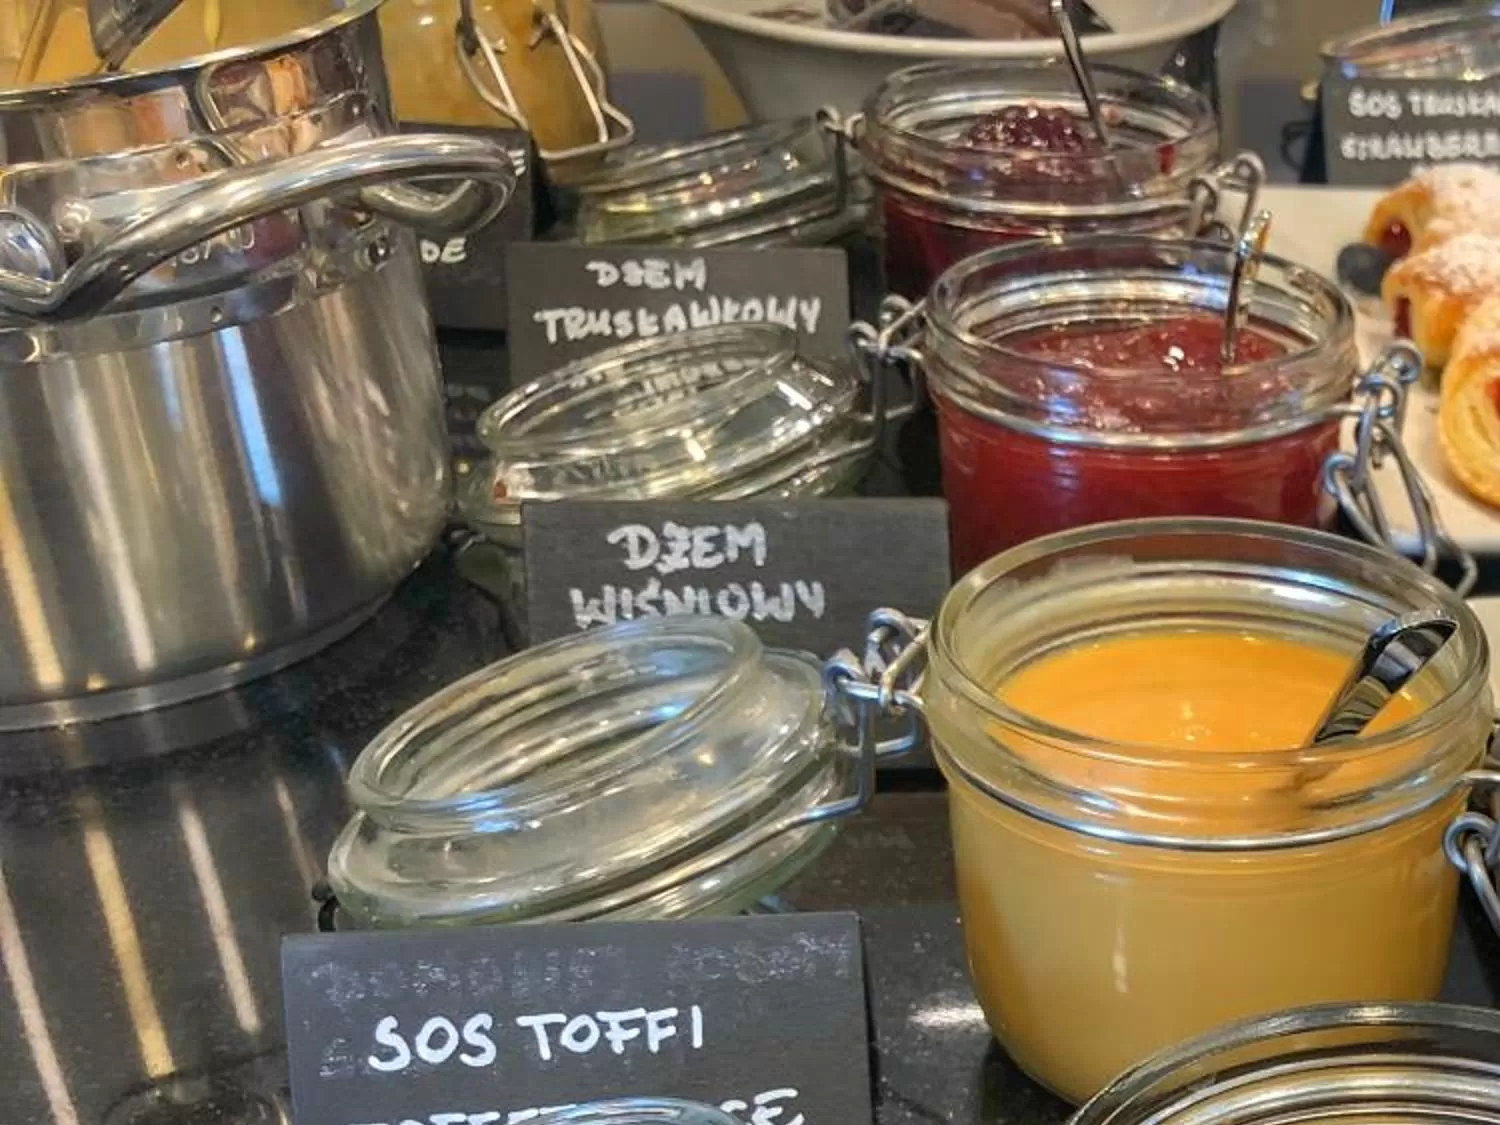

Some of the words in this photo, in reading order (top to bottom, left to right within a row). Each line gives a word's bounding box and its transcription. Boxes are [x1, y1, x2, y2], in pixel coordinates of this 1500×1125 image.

[1348, 87, 1402, 120] SOS
[533, 295, 821, 344] TRUSKAWKOWY
[367, 1012, 497, 1072] SOS
[516, 1004, 704, 1061] TOFFI
